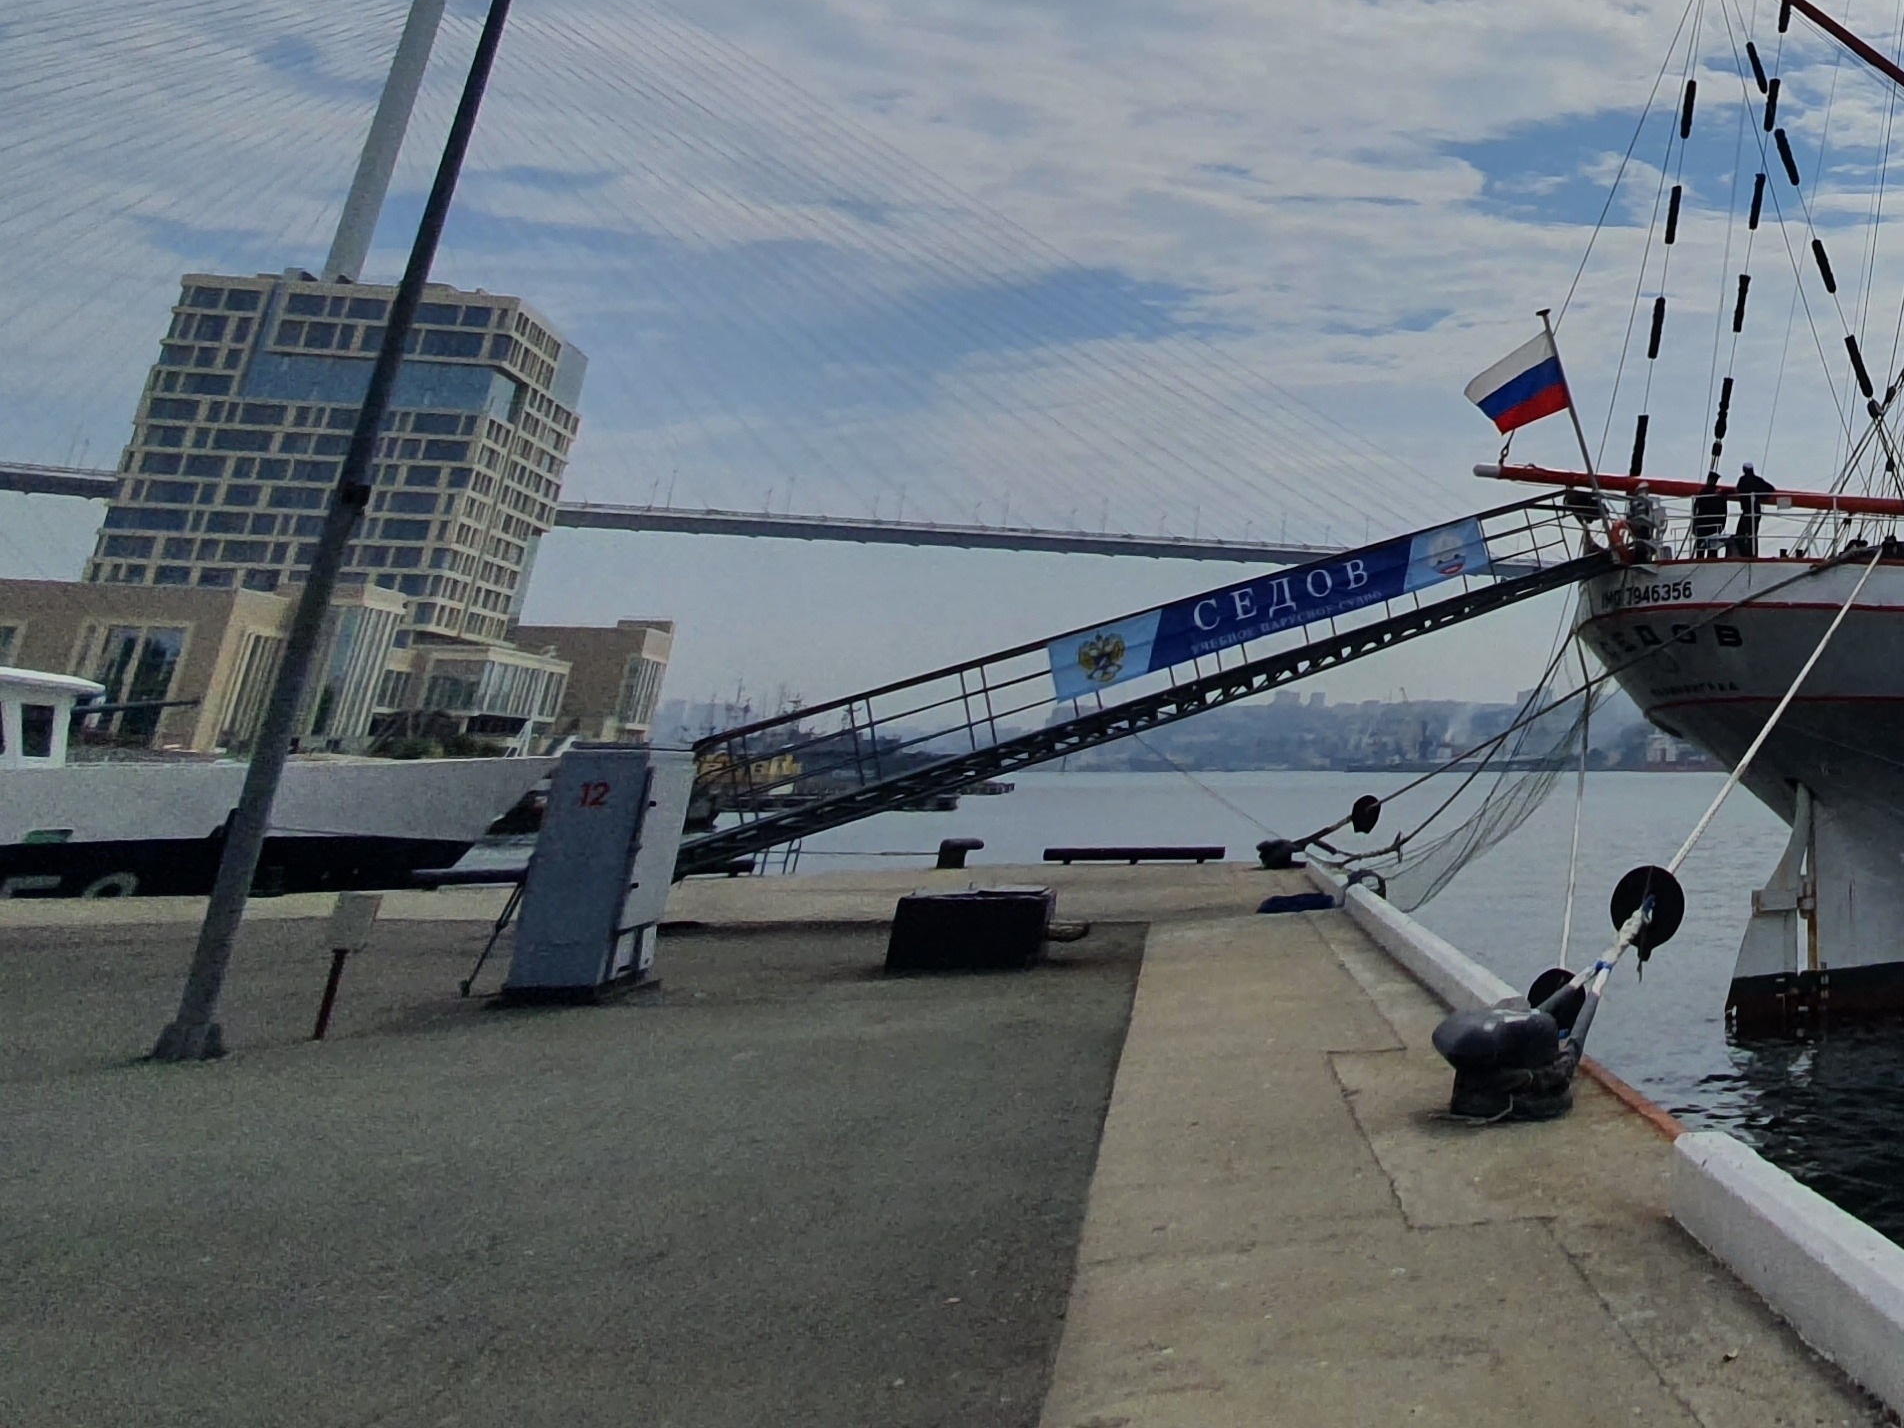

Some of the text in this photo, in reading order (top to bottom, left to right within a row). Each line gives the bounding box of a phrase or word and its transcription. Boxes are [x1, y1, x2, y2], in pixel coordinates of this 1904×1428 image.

[1193, 559, 1369, 631] СЕДОВ
[1625, 581, 1693, 606] 7946356
[1189, 628, 1256, 655] УЧЕБНОЕ
[1260, 604, 1333, 633] ПАРУСНОЕ
[579, 781, 609, 807] 12
